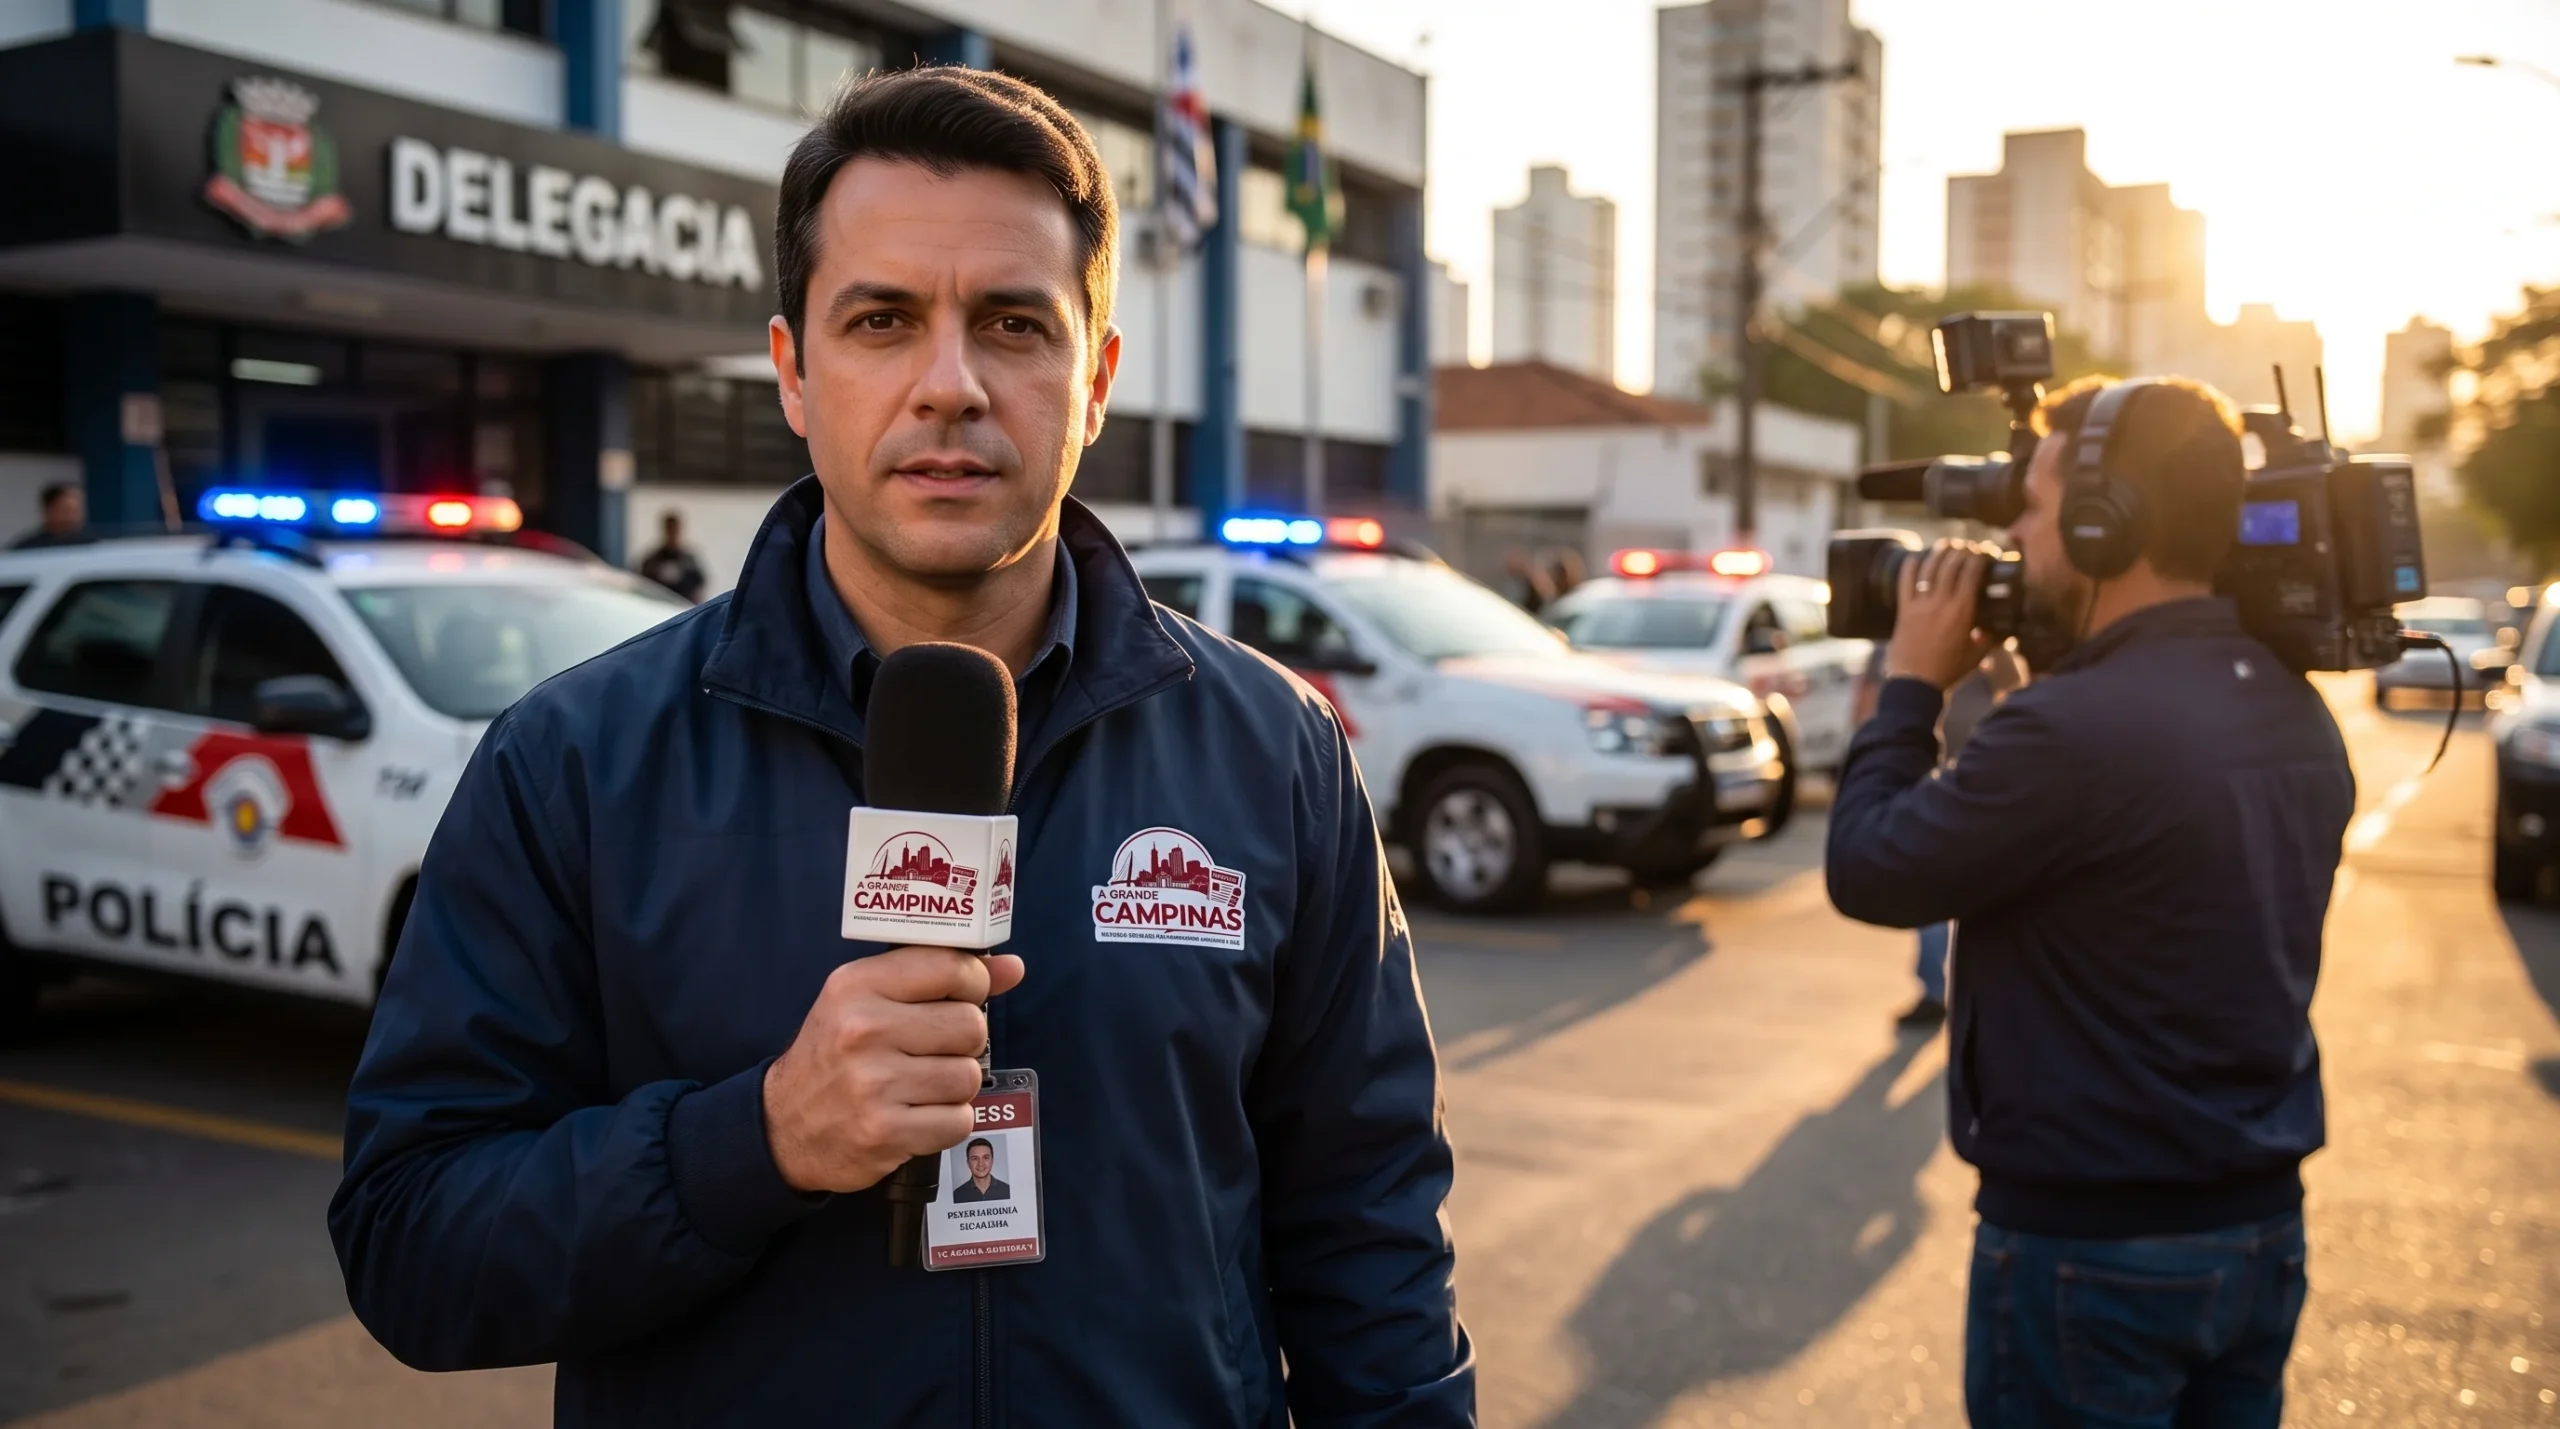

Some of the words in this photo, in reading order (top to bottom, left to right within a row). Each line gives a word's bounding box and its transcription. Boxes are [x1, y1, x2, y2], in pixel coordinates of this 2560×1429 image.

[391, 135, 764, 292] DELEGACIA
[867, 882, 910, 891] GRANDE
[1098, 890, 1107, 899] A
[1109, 889, 1159, 900] GRANDE
[854, 891, 974, 916] CAMPINAS
[1095, 901, 1242, 931] CAMPINAS
[41, 870, 344, 977] POLÍCIA
[974, 1103, 1016, 1124] ESS
